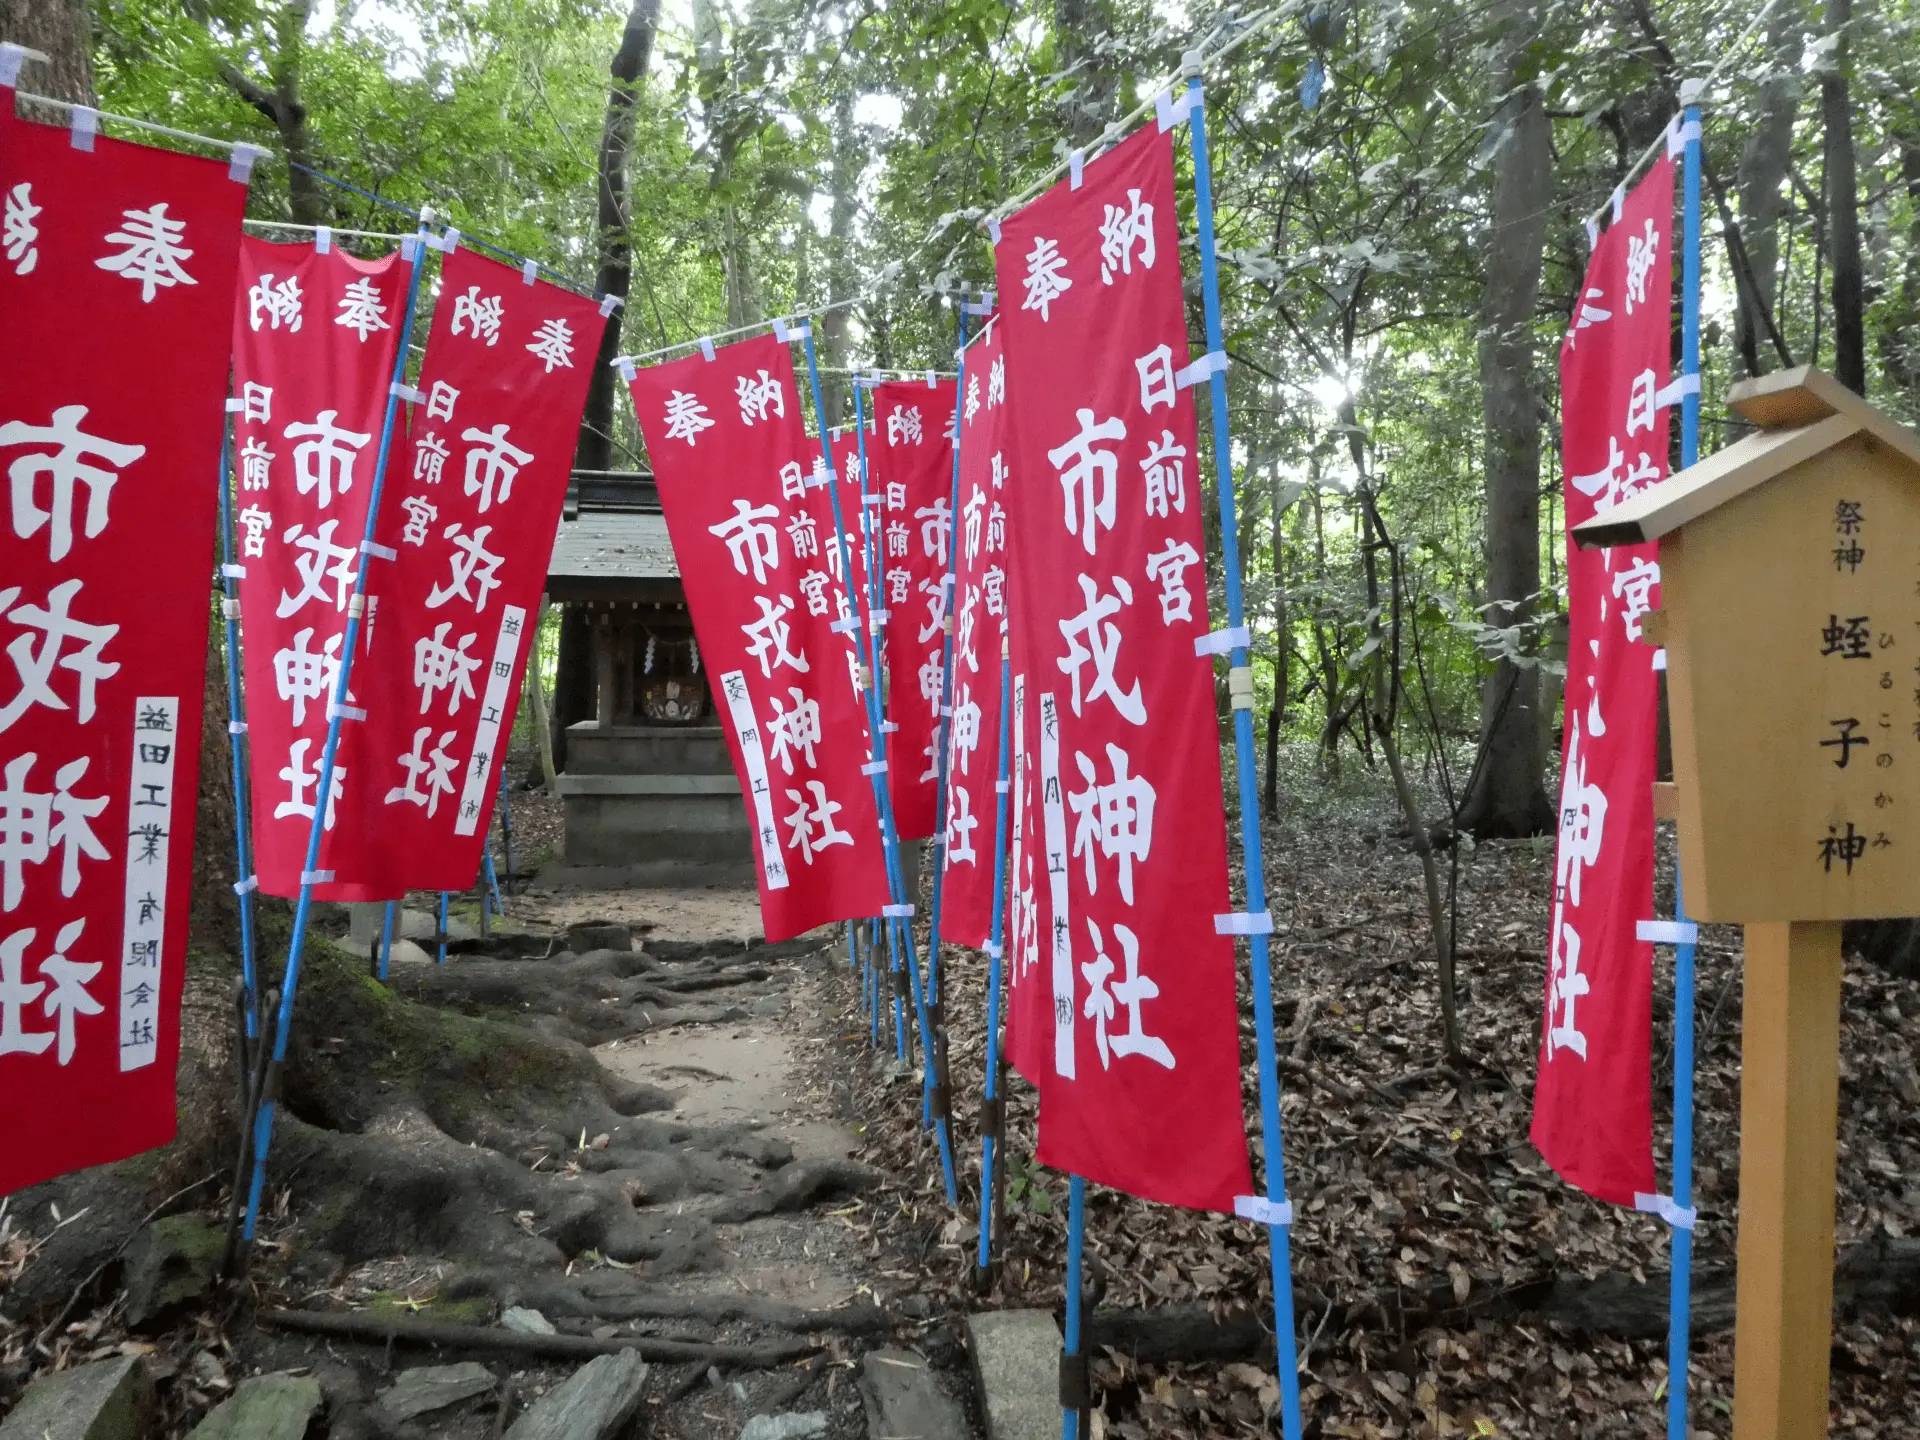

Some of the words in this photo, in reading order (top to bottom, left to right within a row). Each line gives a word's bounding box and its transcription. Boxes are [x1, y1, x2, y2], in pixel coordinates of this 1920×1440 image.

[1022, 188, 1156, 322] 奉納
[664, 370, 784, 446] 奉納
[1135, 343, 1200, 626] 日前宮
[779, 462, 829, 616] 日前宮
[1832, 499, 1865, 575] 祭神
[709, 500, 854, 865] 市戎神社
[1048, 408, 1175, 1071] 市戎神社
[1817, 614, 1873, 876] 蛭子神
[1872, 632, 1895, 849] ひるこのかみ
